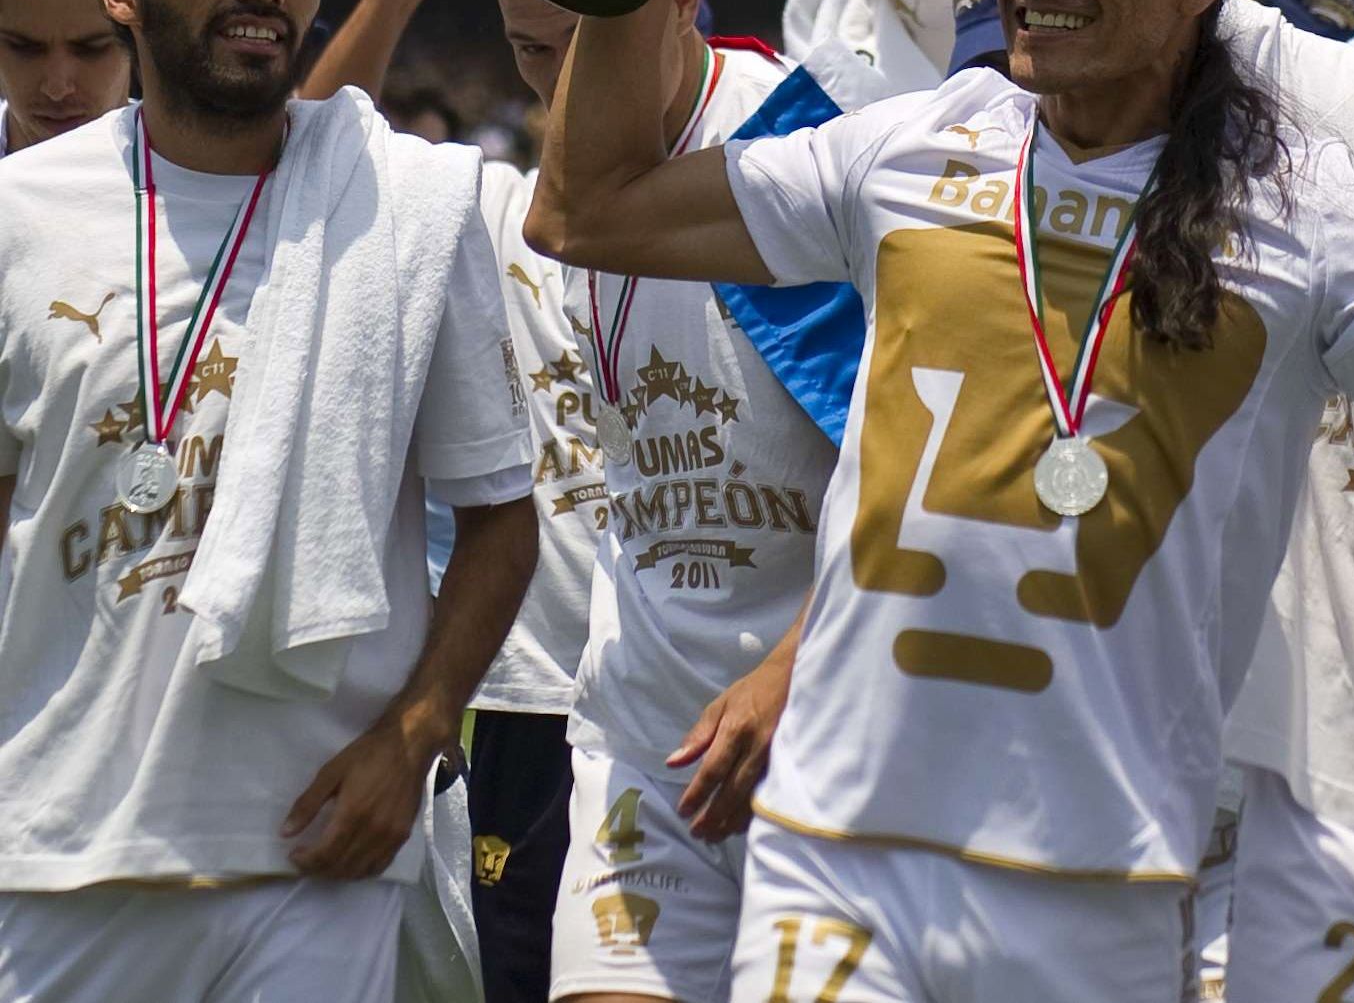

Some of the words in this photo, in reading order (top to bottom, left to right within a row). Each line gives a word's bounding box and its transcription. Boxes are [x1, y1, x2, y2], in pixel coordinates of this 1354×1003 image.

[928, 159, 1140, 240] Banam
[632, 425, 724, 477] UMAS
[670, 561, 720, 589] 2011
[594, 787, 646, 862] 4
